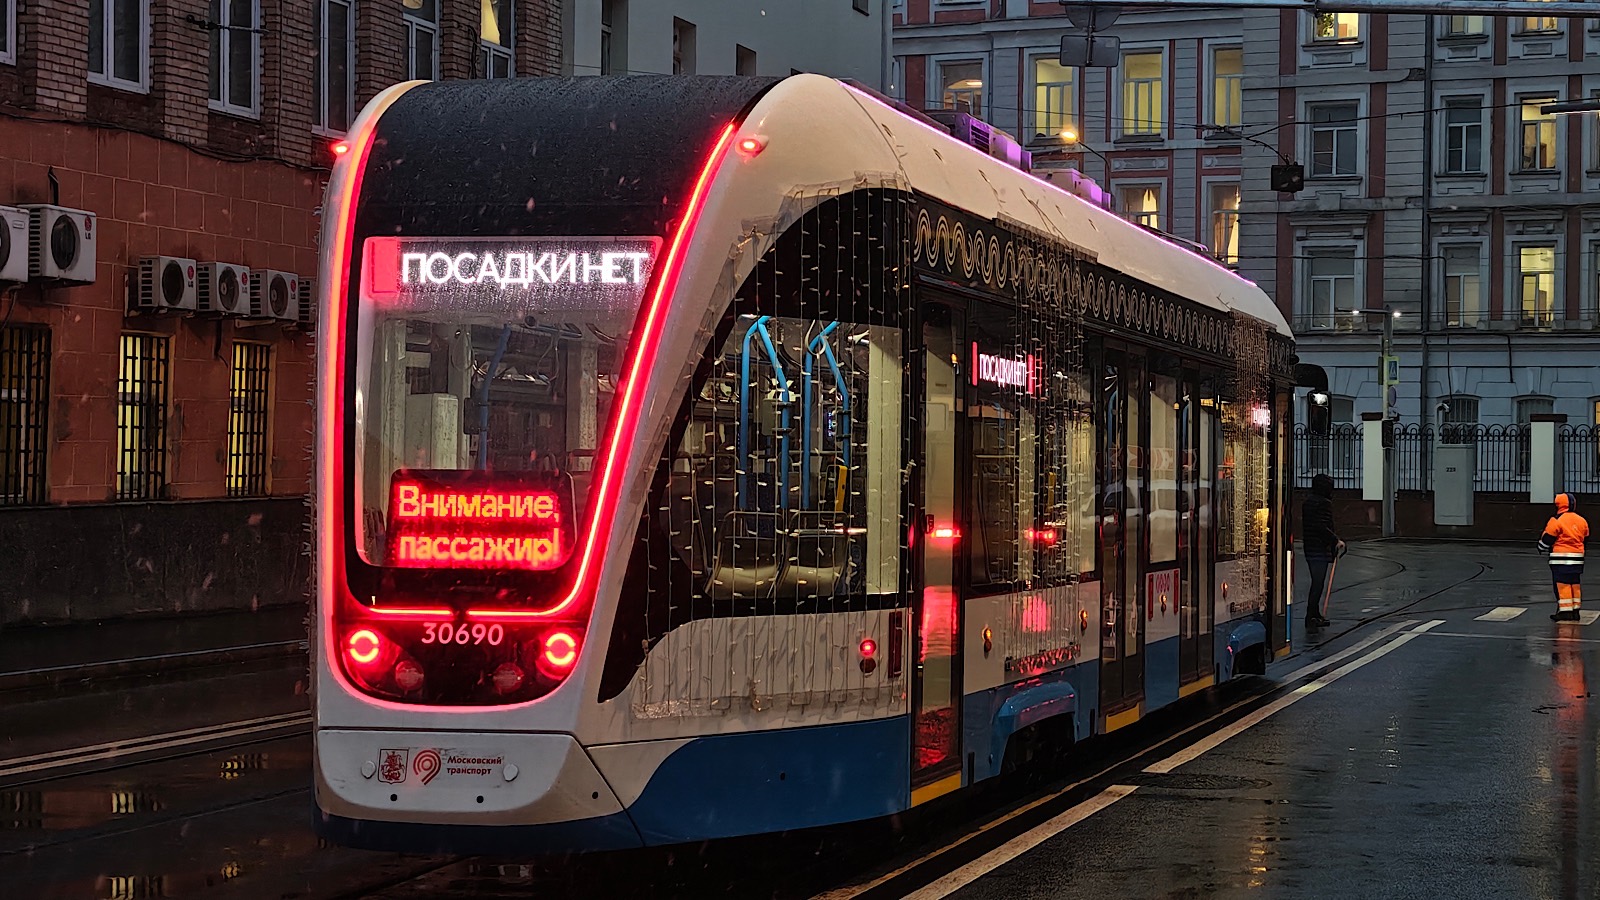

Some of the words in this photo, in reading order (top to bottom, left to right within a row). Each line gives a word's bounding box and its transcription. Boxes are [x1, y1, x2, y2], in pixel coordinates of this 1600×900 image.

[399, 485, 561, 523] Внимание,
[399, 528, 561, 566] пассажир!
[421, 622, 504, 646] 30690
[447, 755, 502, 765] Московский
[447, 767, 492, 776] транспорт
